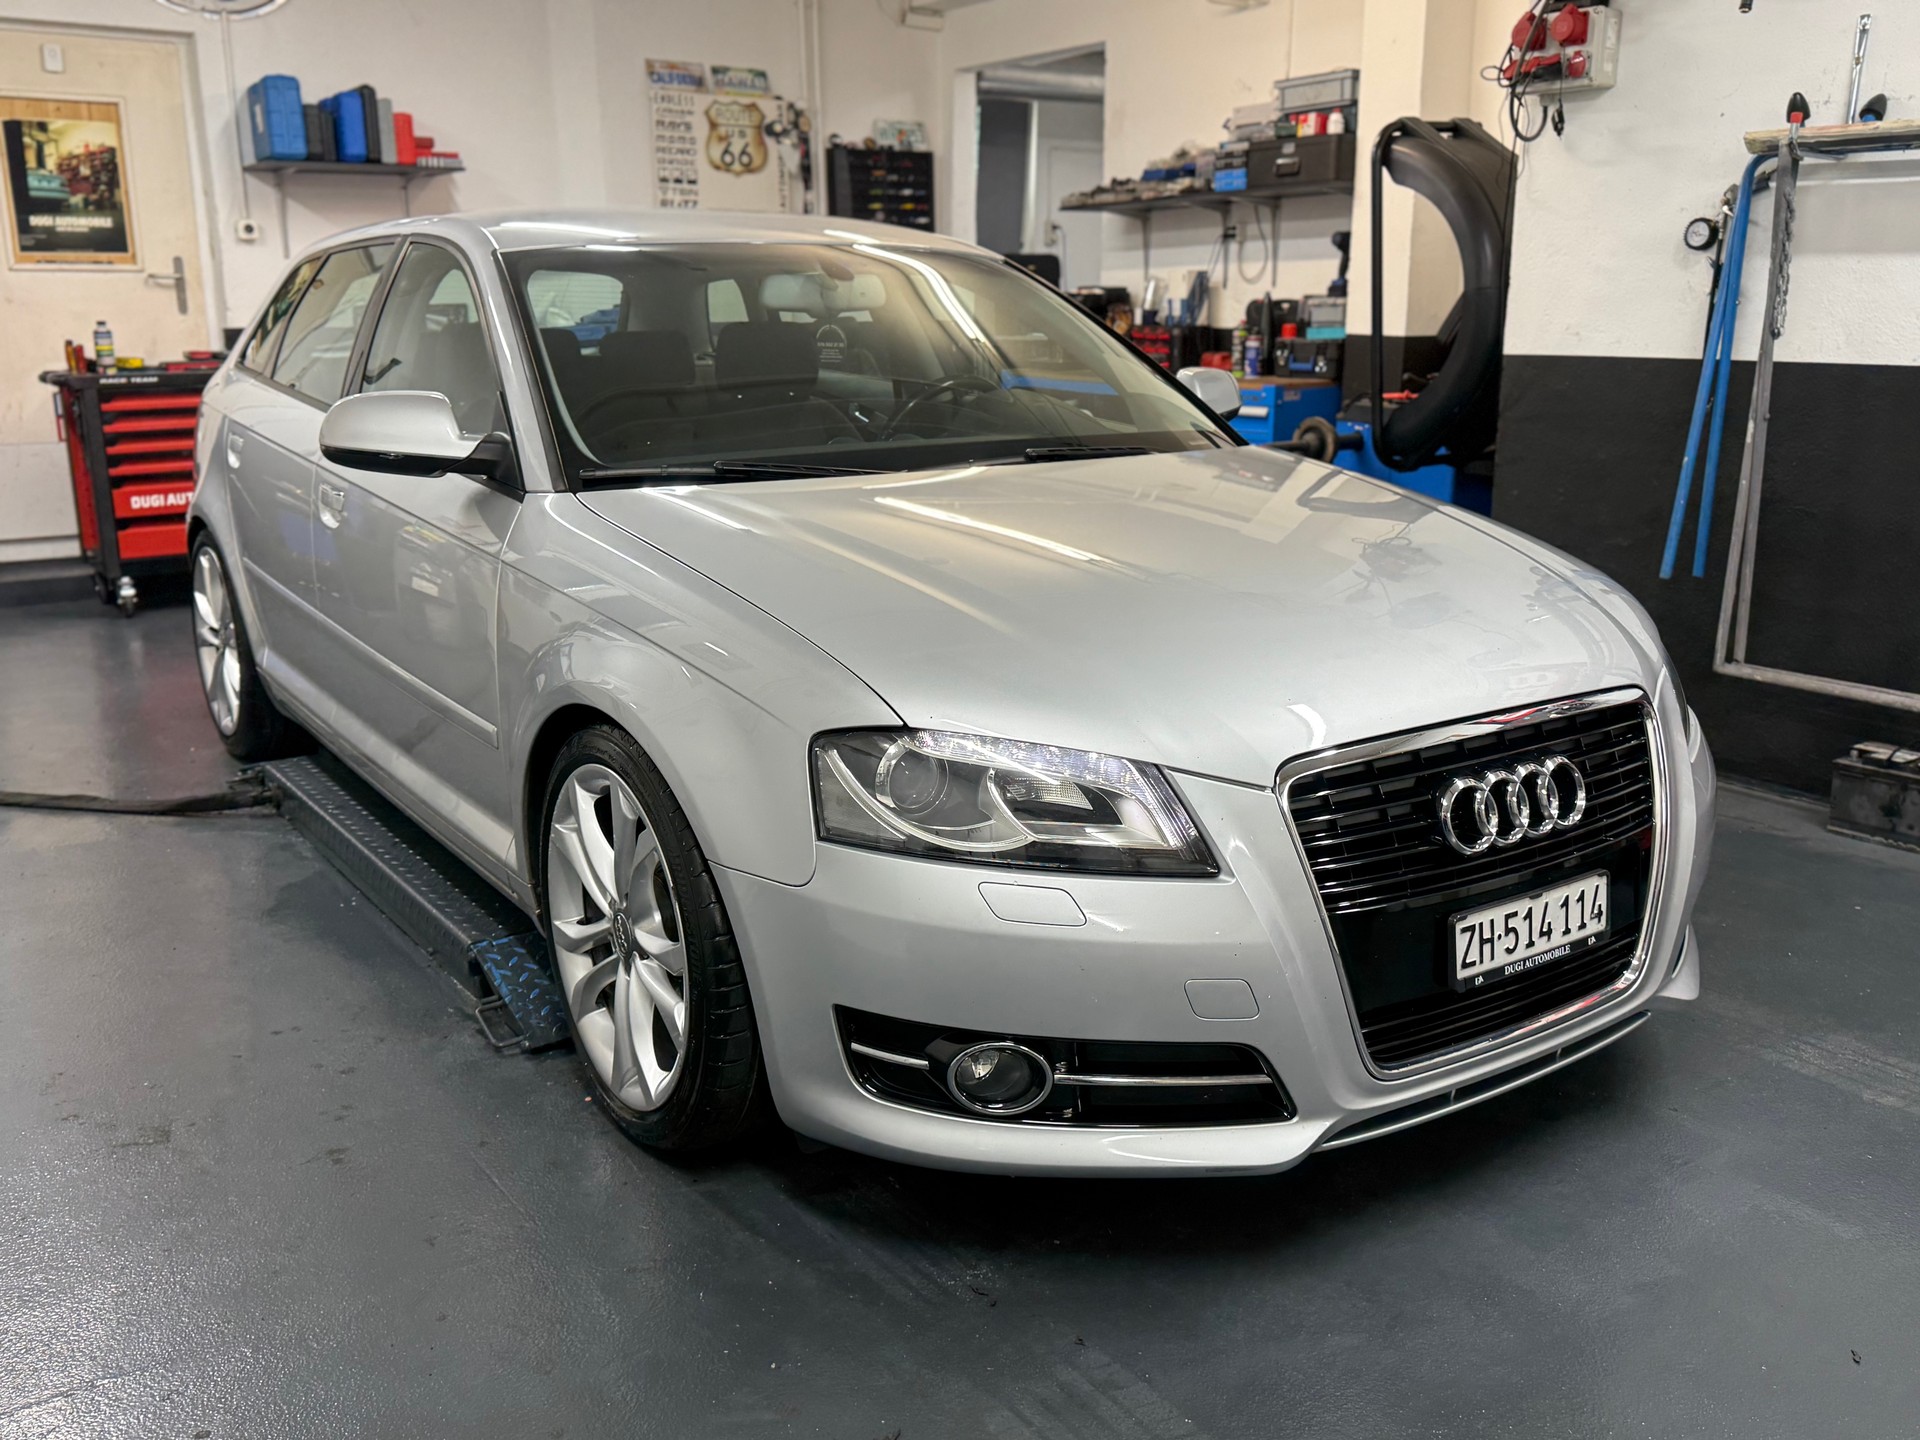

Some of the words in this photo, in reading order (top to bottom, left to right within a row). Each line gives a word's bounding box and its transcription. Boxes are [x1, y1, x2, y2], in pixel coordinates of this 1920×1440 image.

[715, 107, 756, 122] ROUTE
[721, 140, 753, 168] 66
[130, 493, 166, 509] DUGI
[1504, 961, 1524, 976] DUGI
[1524, 944, 1571, 969] AUTOMOBILE
